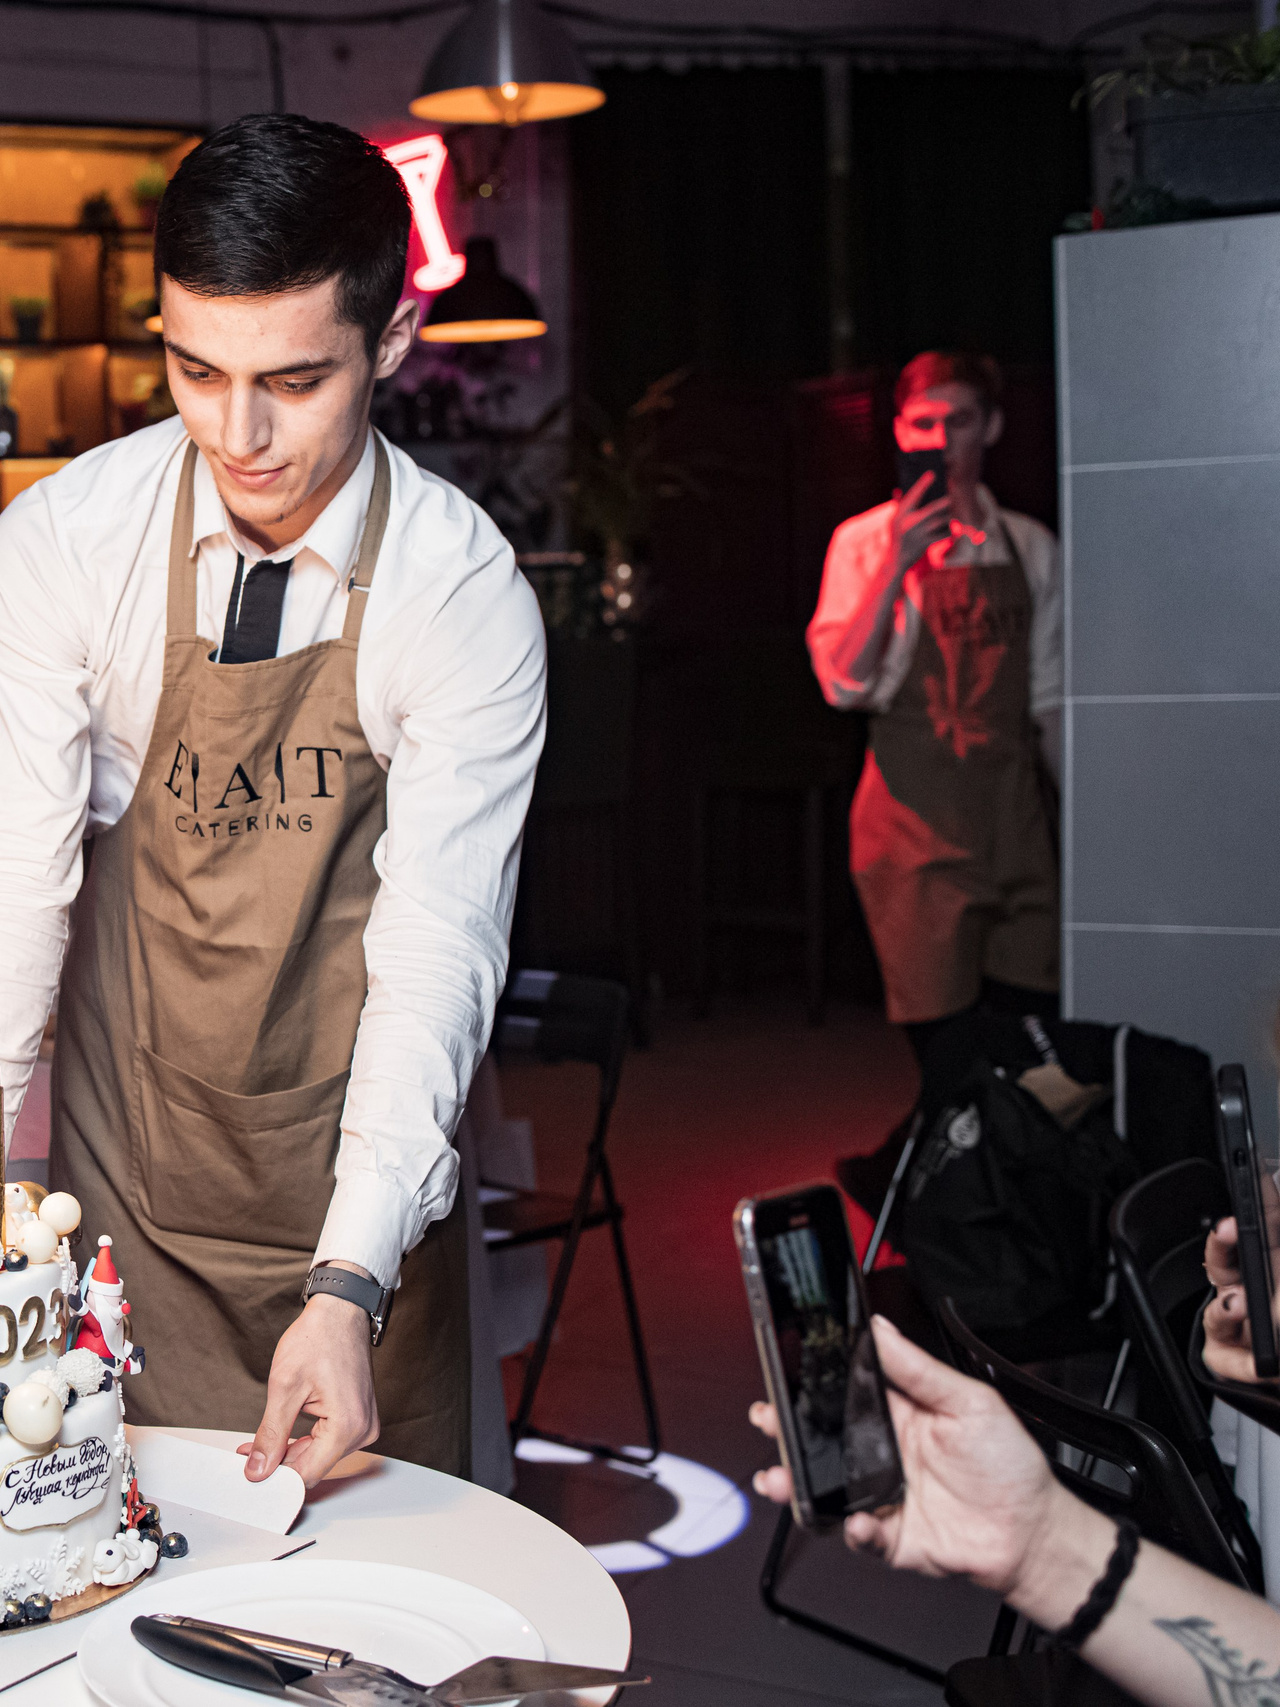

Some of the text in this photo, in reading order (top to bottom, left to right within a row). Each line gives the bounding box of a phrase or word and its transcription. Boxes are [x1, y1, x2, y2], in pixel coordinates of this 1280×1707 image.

[175, 813, 313, 838] CATERING
[5, 1469, 23, 1489] С
[23, 1453, 77, 1484] Новым
[0, 1480, 63, 1517] Лучшая
